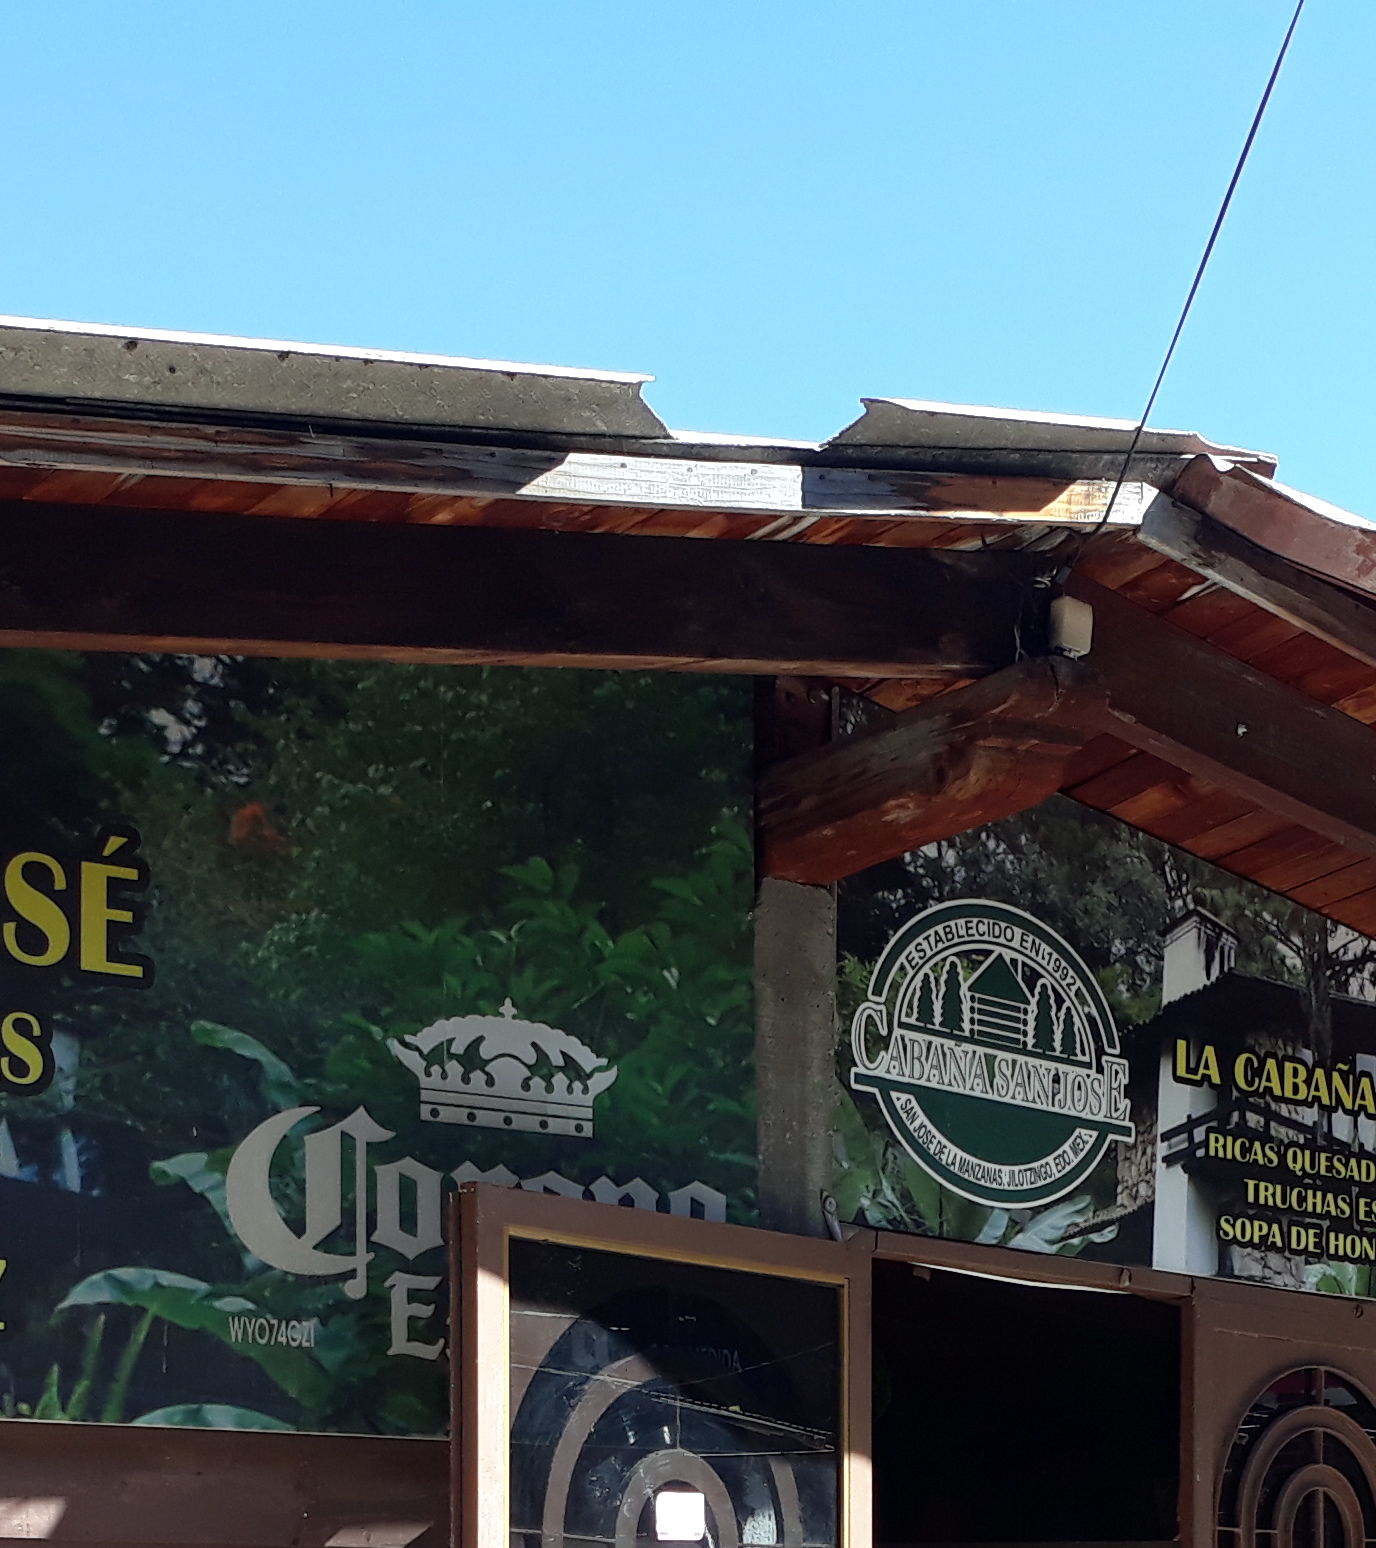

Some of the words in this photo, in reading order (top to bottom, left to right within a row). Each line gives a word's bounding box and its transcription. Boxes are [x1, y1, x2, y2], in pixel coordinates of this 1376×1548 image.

[905, 919, 1015, 970] ESTABLECIDO
[1020, 931, 1042, 958] EN
[1046, 950, 1078, 993] 1992
[854, 1006, 991, 1095] CABAÑA
[993, 1057, 1053, 1105] SAN
[1055, 1060, 1126, 1120] JOSE
[1176, 1039, 1221, 1084] LA
[1234, 1053, 1376, 1114] CABAÑA
[901, 1098, 920, 1127] SAN
[913, 1120, 937, 1152] JOSE
[933, 1140, 948, 1162] DE
[945, 1149, 957, 1170] LA
[1209, 1132, 1278, 1167] RICAS
[1219, 1215, 1283, 1248] SOPA
[1290, 1226, 1322, 1252] DE
[1244, 1178, 1351, 1218] TRUCHAS
